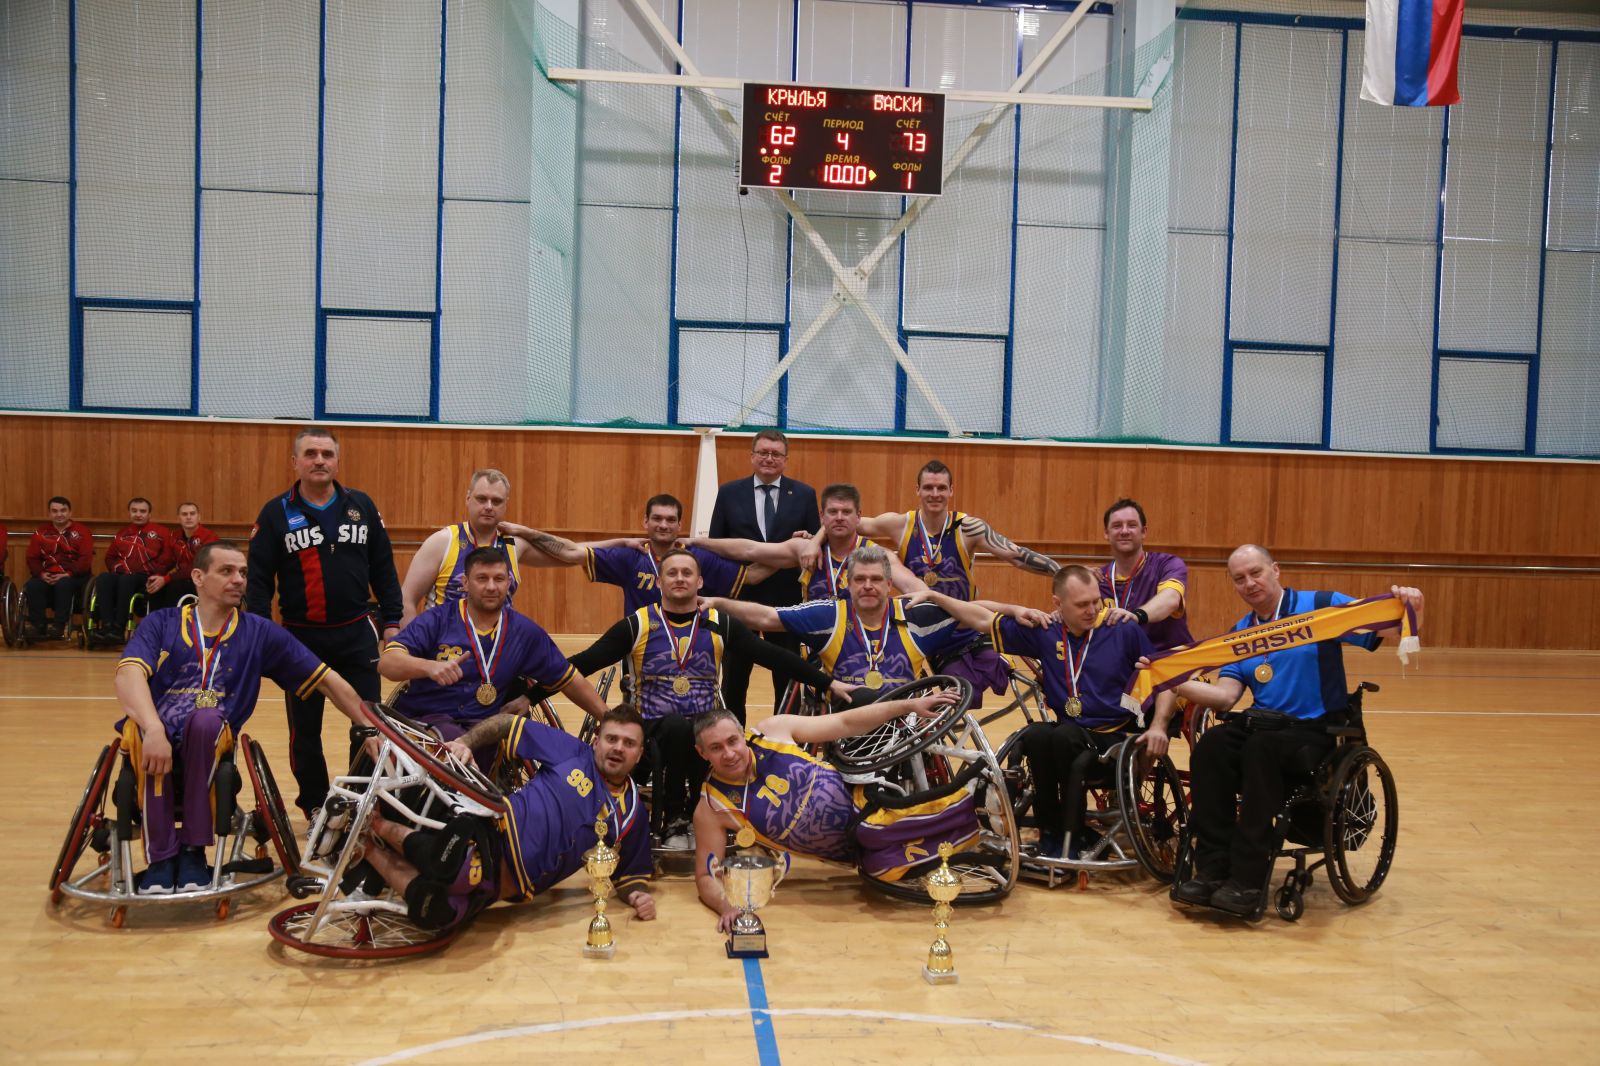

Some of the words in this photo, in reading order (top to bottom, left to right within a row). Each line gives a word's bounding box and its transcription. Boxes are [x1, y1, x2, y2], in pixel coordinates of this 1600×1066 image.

[767, 88, 828, 108] КРЫЛЬЯ
[873, 94, 922, 113] БАСКИ
[764, 112, 790, 122] СЧЁТ
[823, 118, 865, 130] ПЕРИОД
[896, 119, 921, 129] СЧЁТ
[770, 125, 796, 145] 62
[837, 132, 849, 151] 4
[903, 132, 926, 152] 73
[761, 155, 791, 165] ФОЛЫ
[825, 154, 860, 164] ВРЕМЯ
[892, 162, 922, 171] ФОЛЫ
[769, 165, 782, 184] 2
[906, 172, 912, 190] 1
[636, 571, 655, 590] 77
[1231, 625, 1314, 657] BASKI
[566, 768, 594, 798] 99
